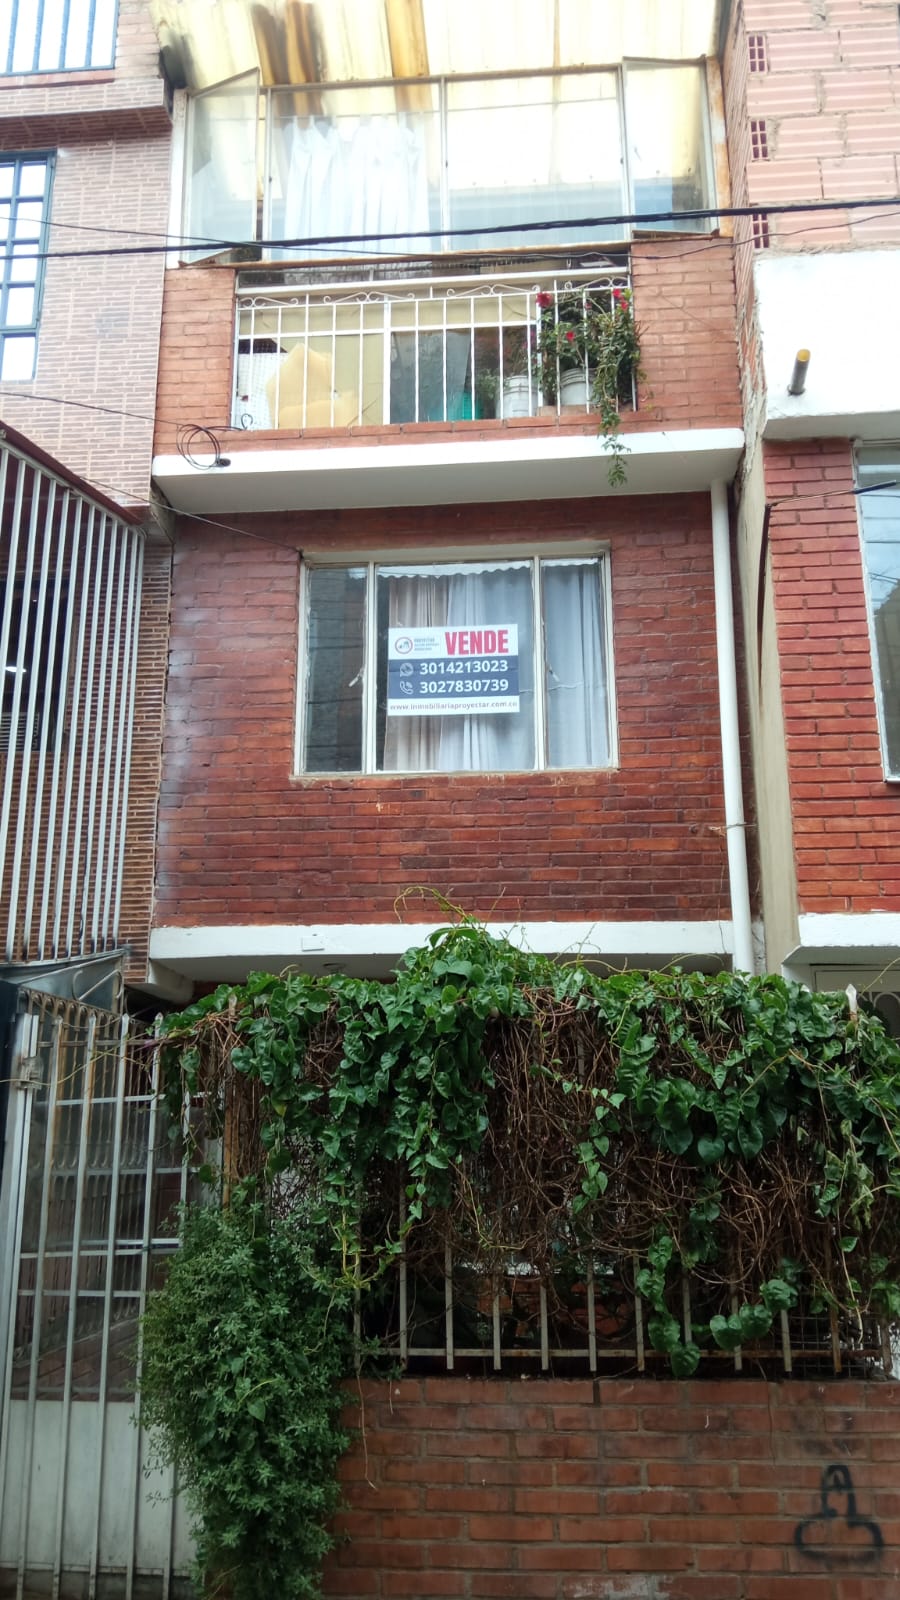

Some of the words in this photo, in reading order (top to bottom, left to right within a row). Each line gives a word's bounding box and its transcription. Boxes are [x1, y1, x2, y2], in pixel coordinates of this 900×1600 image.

[445, 629, 509, 656] VENDE
[419, 660, 509, 675] 3014213023
[419, 679, 509, 694] 3027830739
